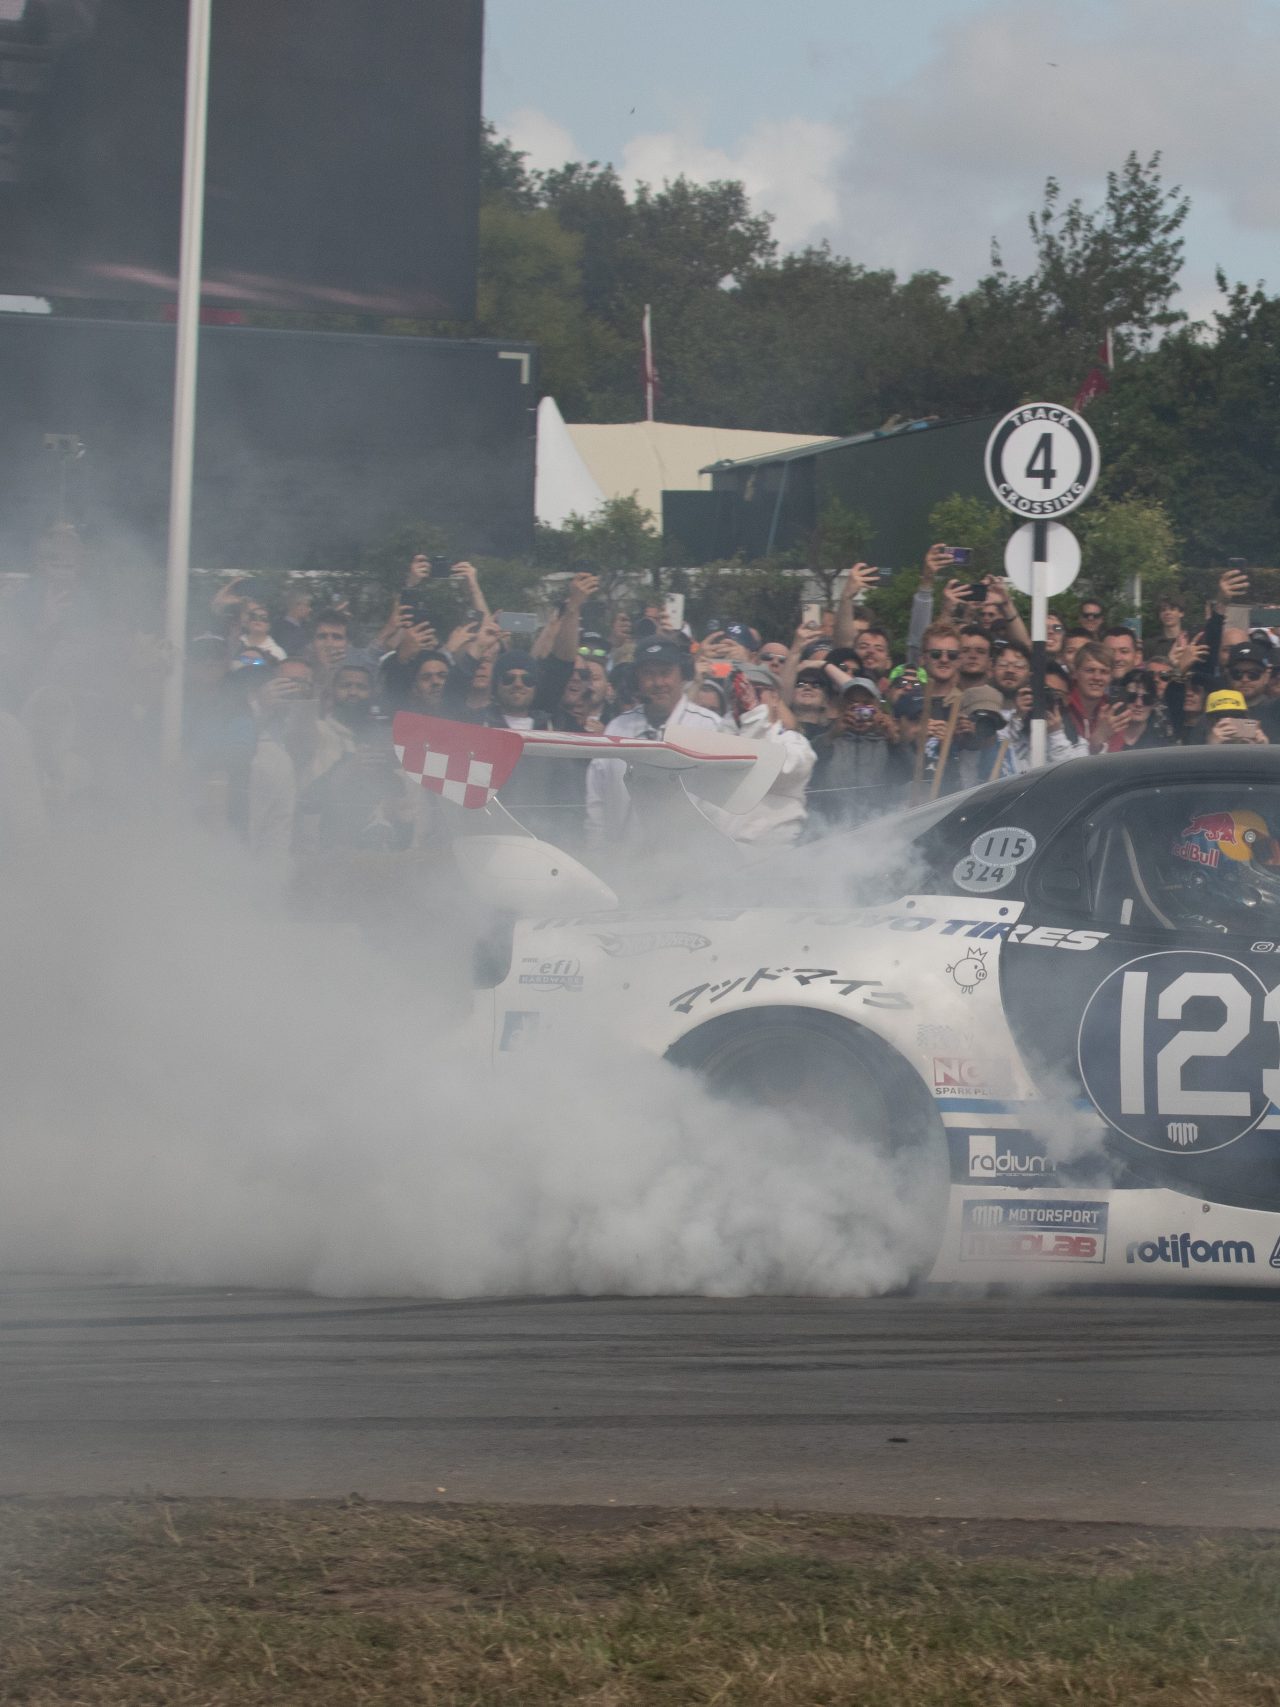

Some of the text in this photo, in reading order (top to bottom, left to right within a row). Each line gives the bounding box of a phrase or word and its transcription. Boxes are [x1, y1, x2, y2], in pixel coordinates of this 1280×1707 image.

[1009, 407, 1073, 429] TRACK
[1025, 432, 1057, 490] 4
[998, 482, 1086, 514] CROSSING
[984, 837, 1029, 858] 115
[1190, 843, 1219, 868] Bull
[961, 860, 1005, 883] 324
[939, 918, 1111, 950] TIRES
[970, 1149, 1058, 1172] radium
[1008, 1208, 1100, 1224] MOTORSPORT
[1126, 1232, 1256, 1268] rotiform
